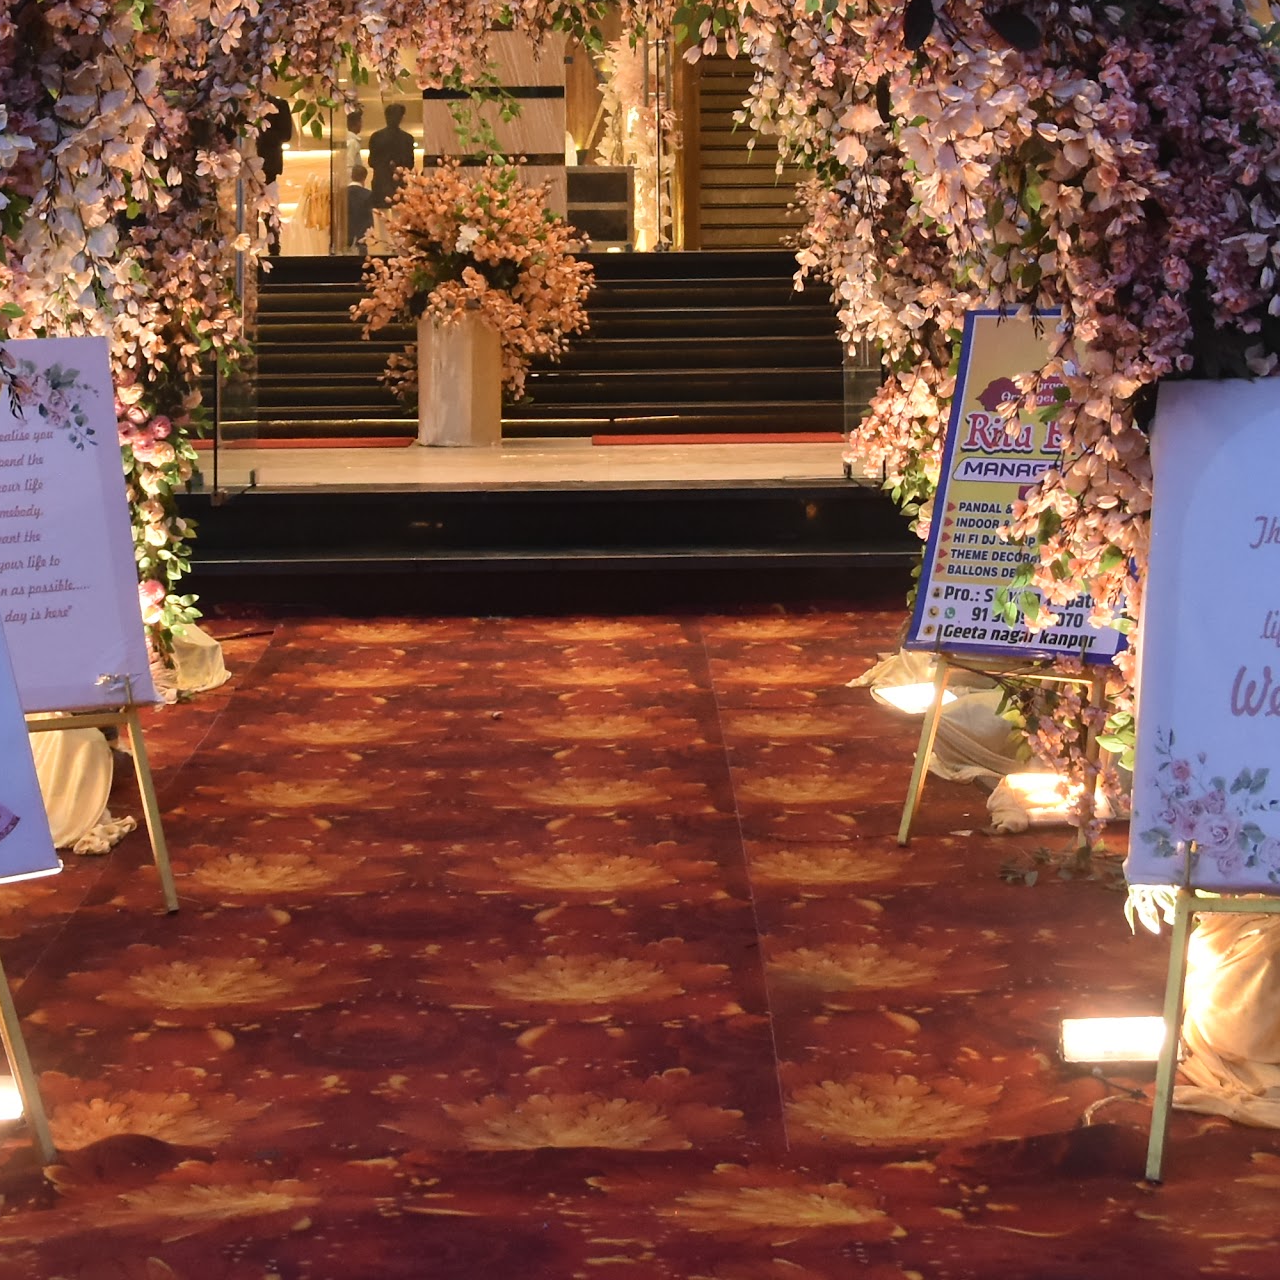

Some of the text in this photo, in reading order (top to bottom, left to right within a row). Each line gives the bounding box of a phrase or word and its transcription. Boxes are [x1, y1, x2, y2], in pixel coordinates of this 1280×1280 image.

[33, 430, 54, 444] you
[27, 453, 44, 466] the
[24, 478, 44, 494] life
[958, 501, 1002, 513] PANDAL
[956, 517, 999, 529] INDOOR
[24, 530, 41, 543] the
[953, 533, 965, 543] HI
[968, 534, 978, 544] FI
[982, 535, 996, 545] DJ
[950, 549, 988, 561] THEME
[27, 555, 47, 571] life
[49, 554, 60, 566] to
[947, 564, 998, 578] BALLONS
[11, 586, 25, 596] as
[4, 610, 28, 625] day
[30, 607, 41, 620] is
[971, 606, 988, 622] 91
[943, 624, 986, 640] Geeta
[990, 628, 1035, 644] nagar
